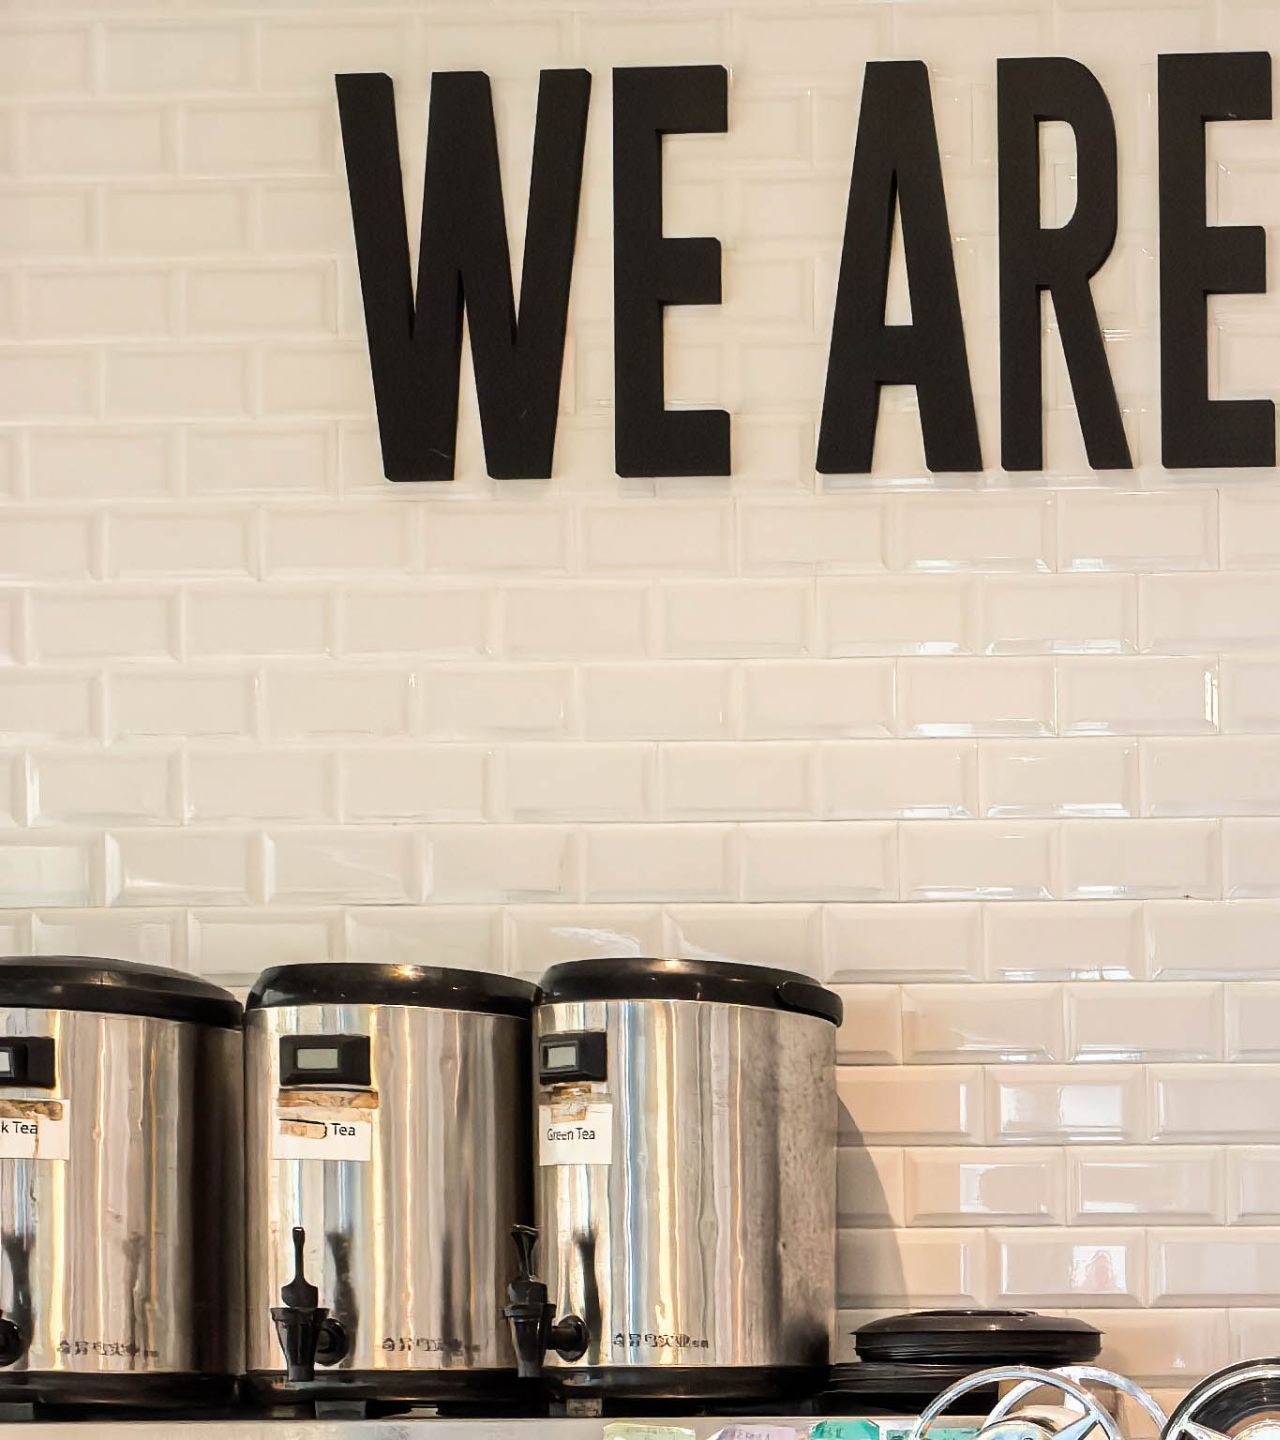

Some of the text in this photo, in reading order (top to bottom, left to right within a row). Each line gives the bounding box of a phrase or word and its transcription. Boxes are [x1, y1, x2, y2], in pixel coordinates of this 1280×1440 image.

[335, 65, 731, 482] WE
[815, 52, 1277, 475] ARE
[12, 1120, 38, 1135] Tea
[329, 1122, 356, 1136] Tea
[547, 1127, 596, 1141] Green Tea
